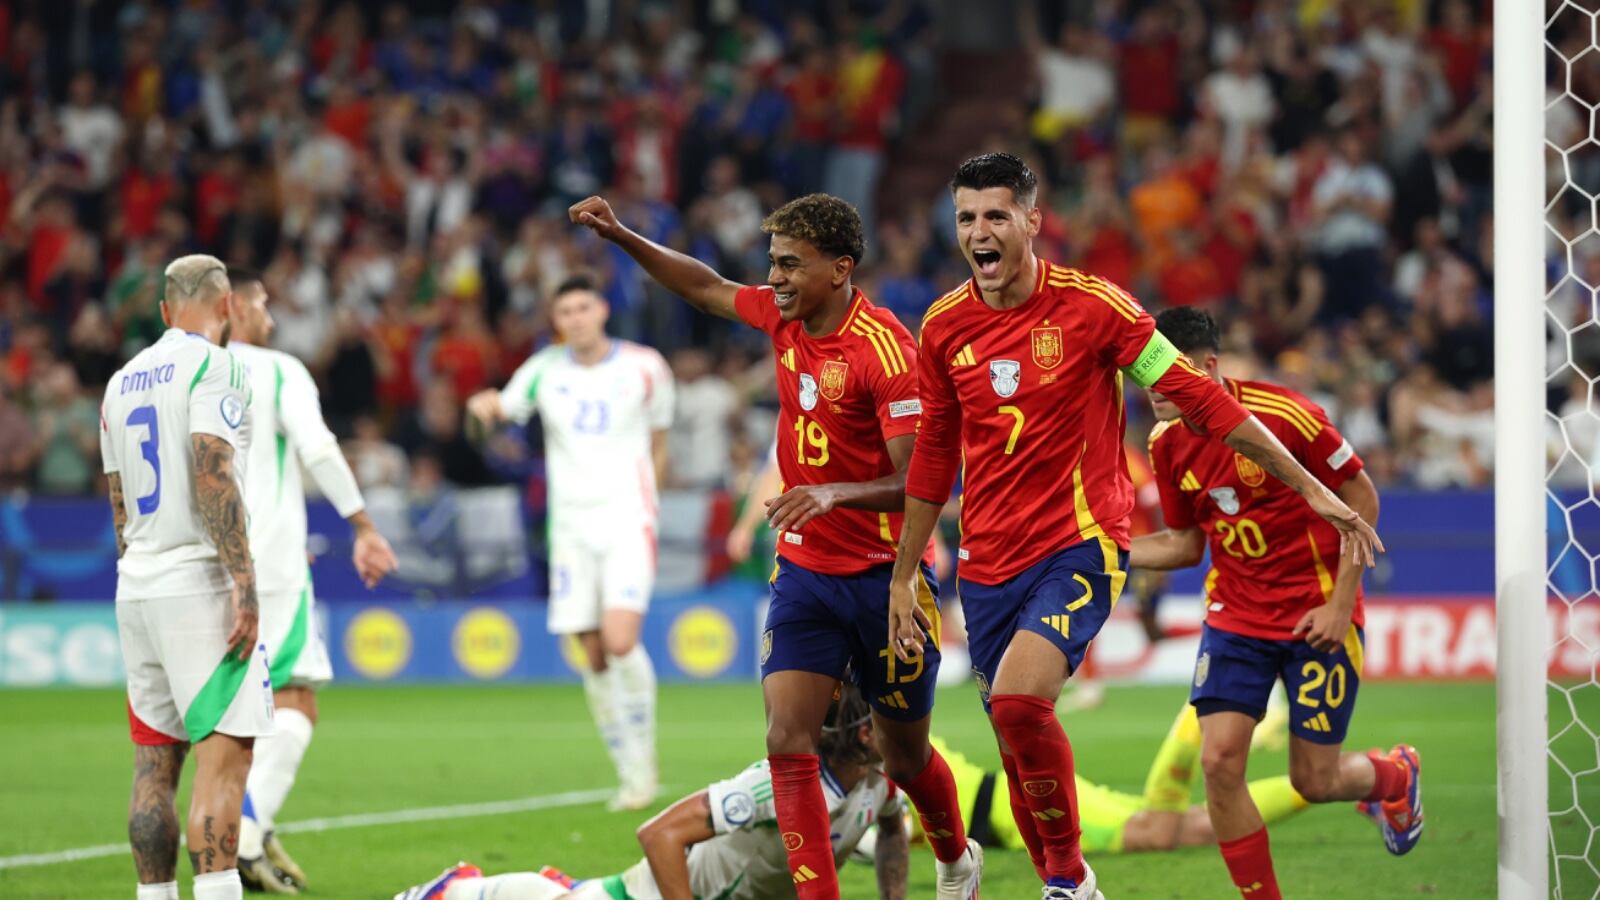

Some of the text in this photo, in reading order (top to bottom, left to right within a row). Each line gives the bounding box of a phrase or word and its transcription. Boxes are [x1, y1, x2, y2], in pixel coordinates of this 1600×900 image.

[573, 399, 610, 433] 23
[998, 405, 1025, 455] 7
[126, 404, 160, 515] 3
[794, 415, 830, 467] 19
[1215, 518, 1268, 558] 20
[1065, 573, 1093, 612] 7
[879, 645, 925, 684] 19
[1296, 661, 1346, 709] 20
